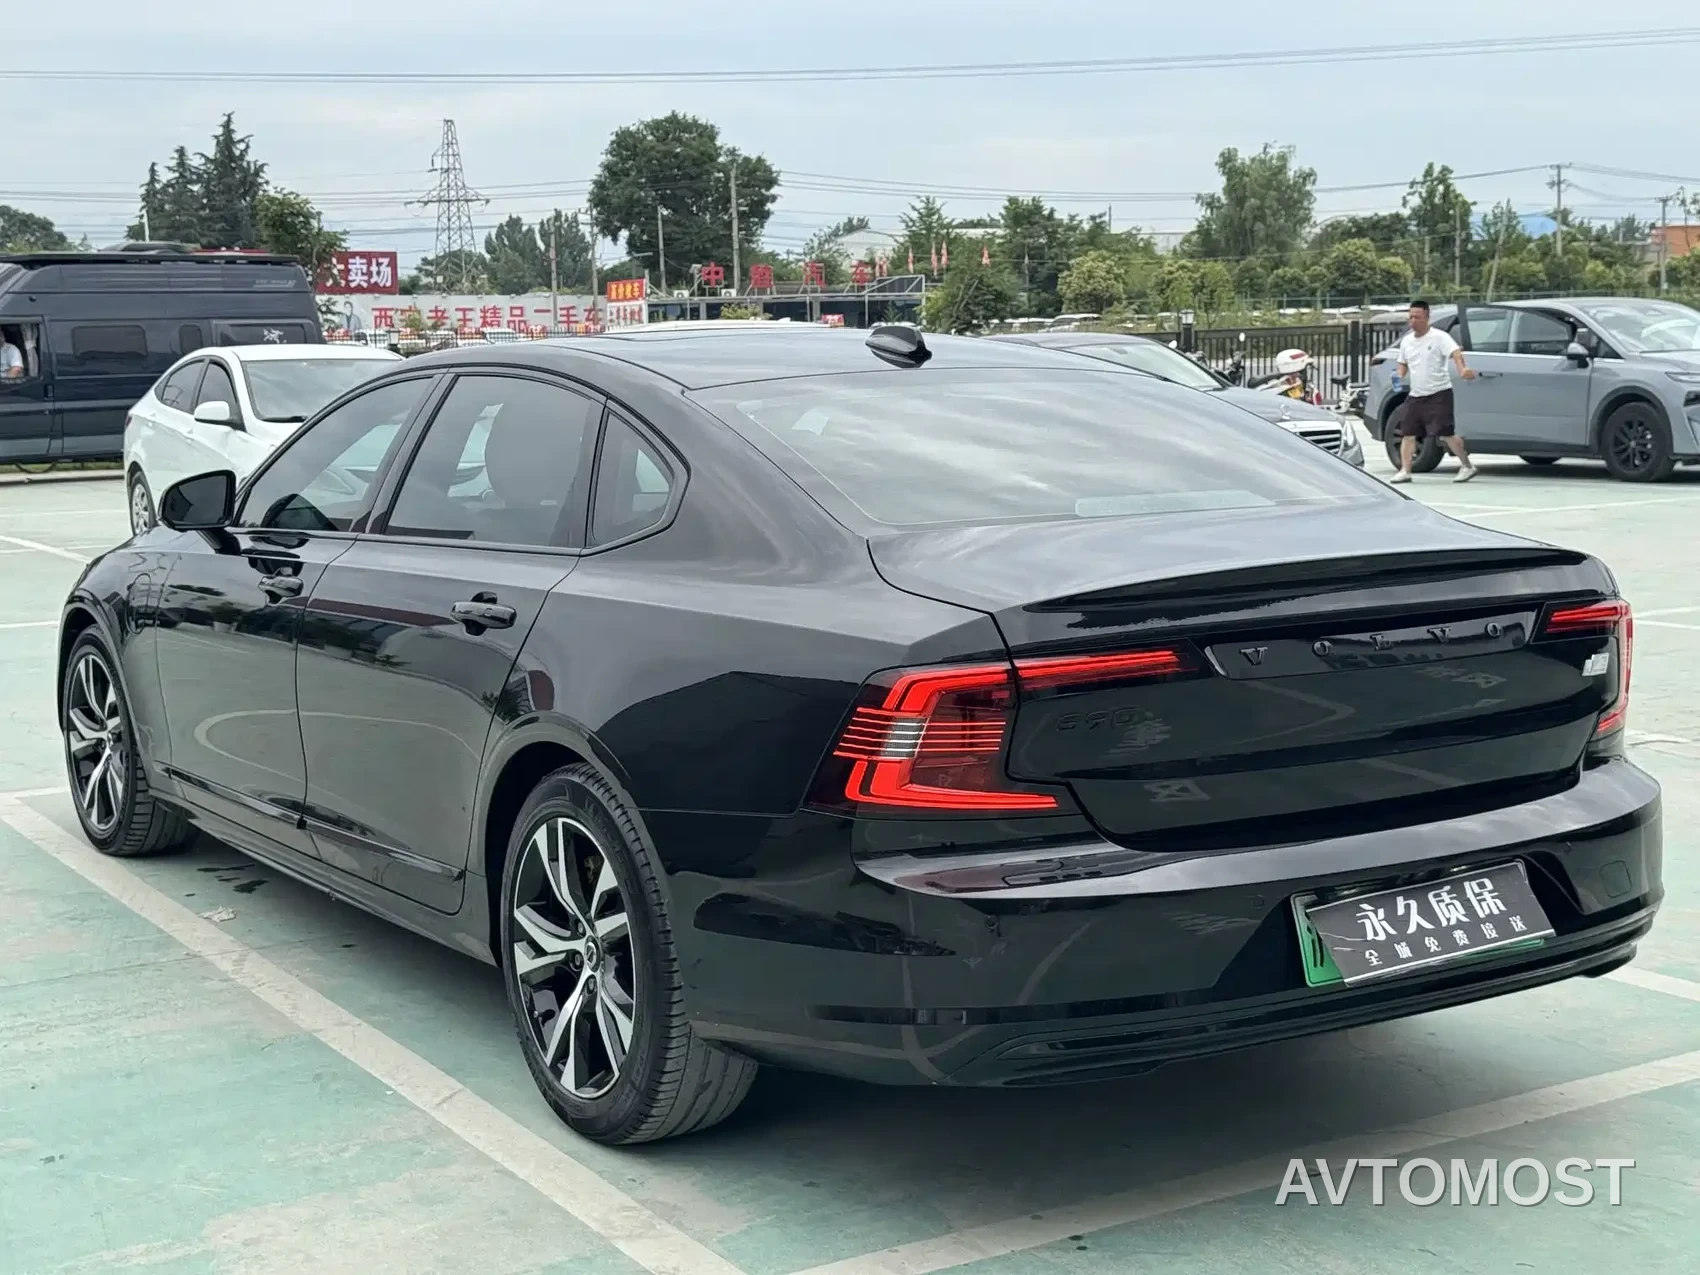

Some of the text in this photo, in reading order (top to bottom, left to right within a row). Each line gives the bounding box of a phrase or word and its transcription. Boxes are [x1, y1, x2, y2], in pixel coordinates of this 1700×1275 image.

[1239, 622, 1501, 666] VOLVO
[1056, 705, 1141, 732] S90
[1356, 877, 1508, 942] 永久质保
[1364, 915, 1529, 967] 全城免费接送
